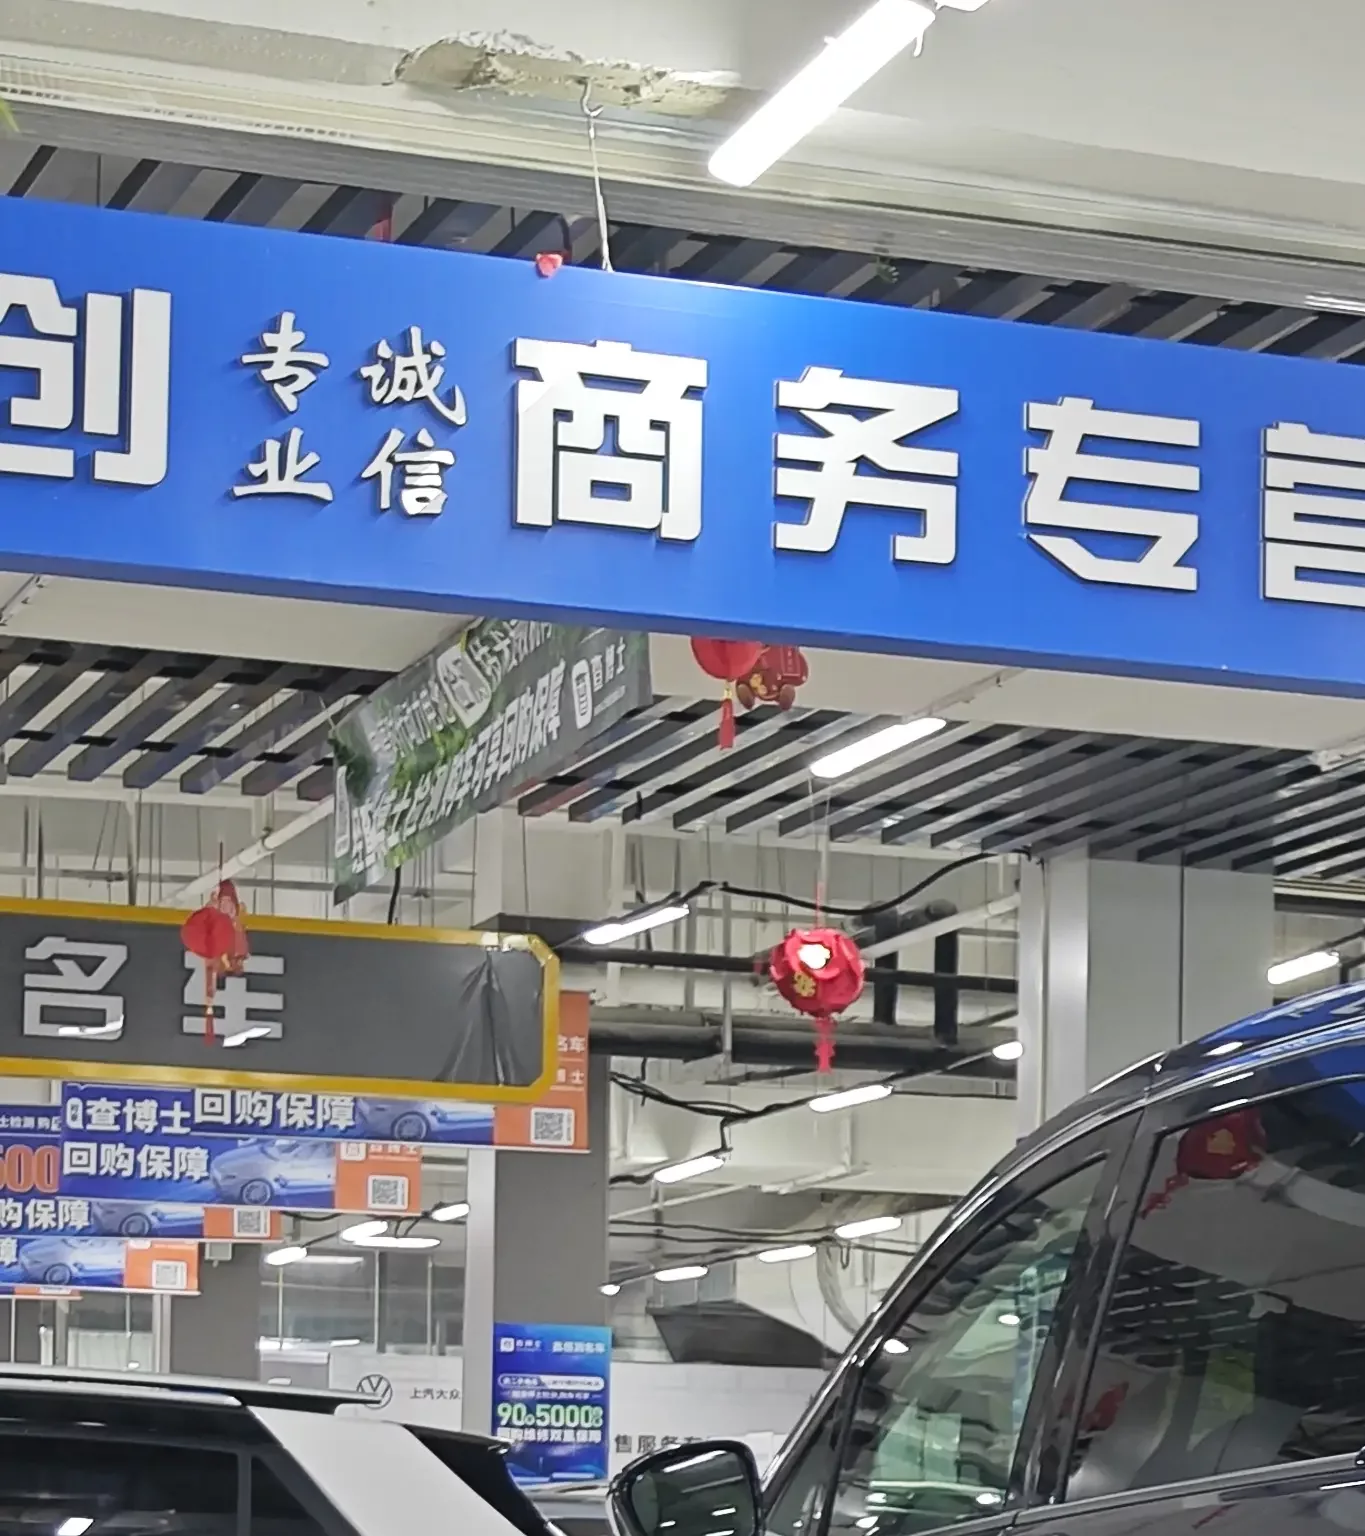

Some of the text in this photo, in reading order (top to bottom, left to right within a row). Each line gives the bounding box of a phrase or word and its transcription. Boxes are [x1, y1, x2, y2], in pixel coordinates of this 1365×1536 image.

[194, 1087, 357, 1130] 回购保障
[63, 1141, 210, 1182] 回购保障
